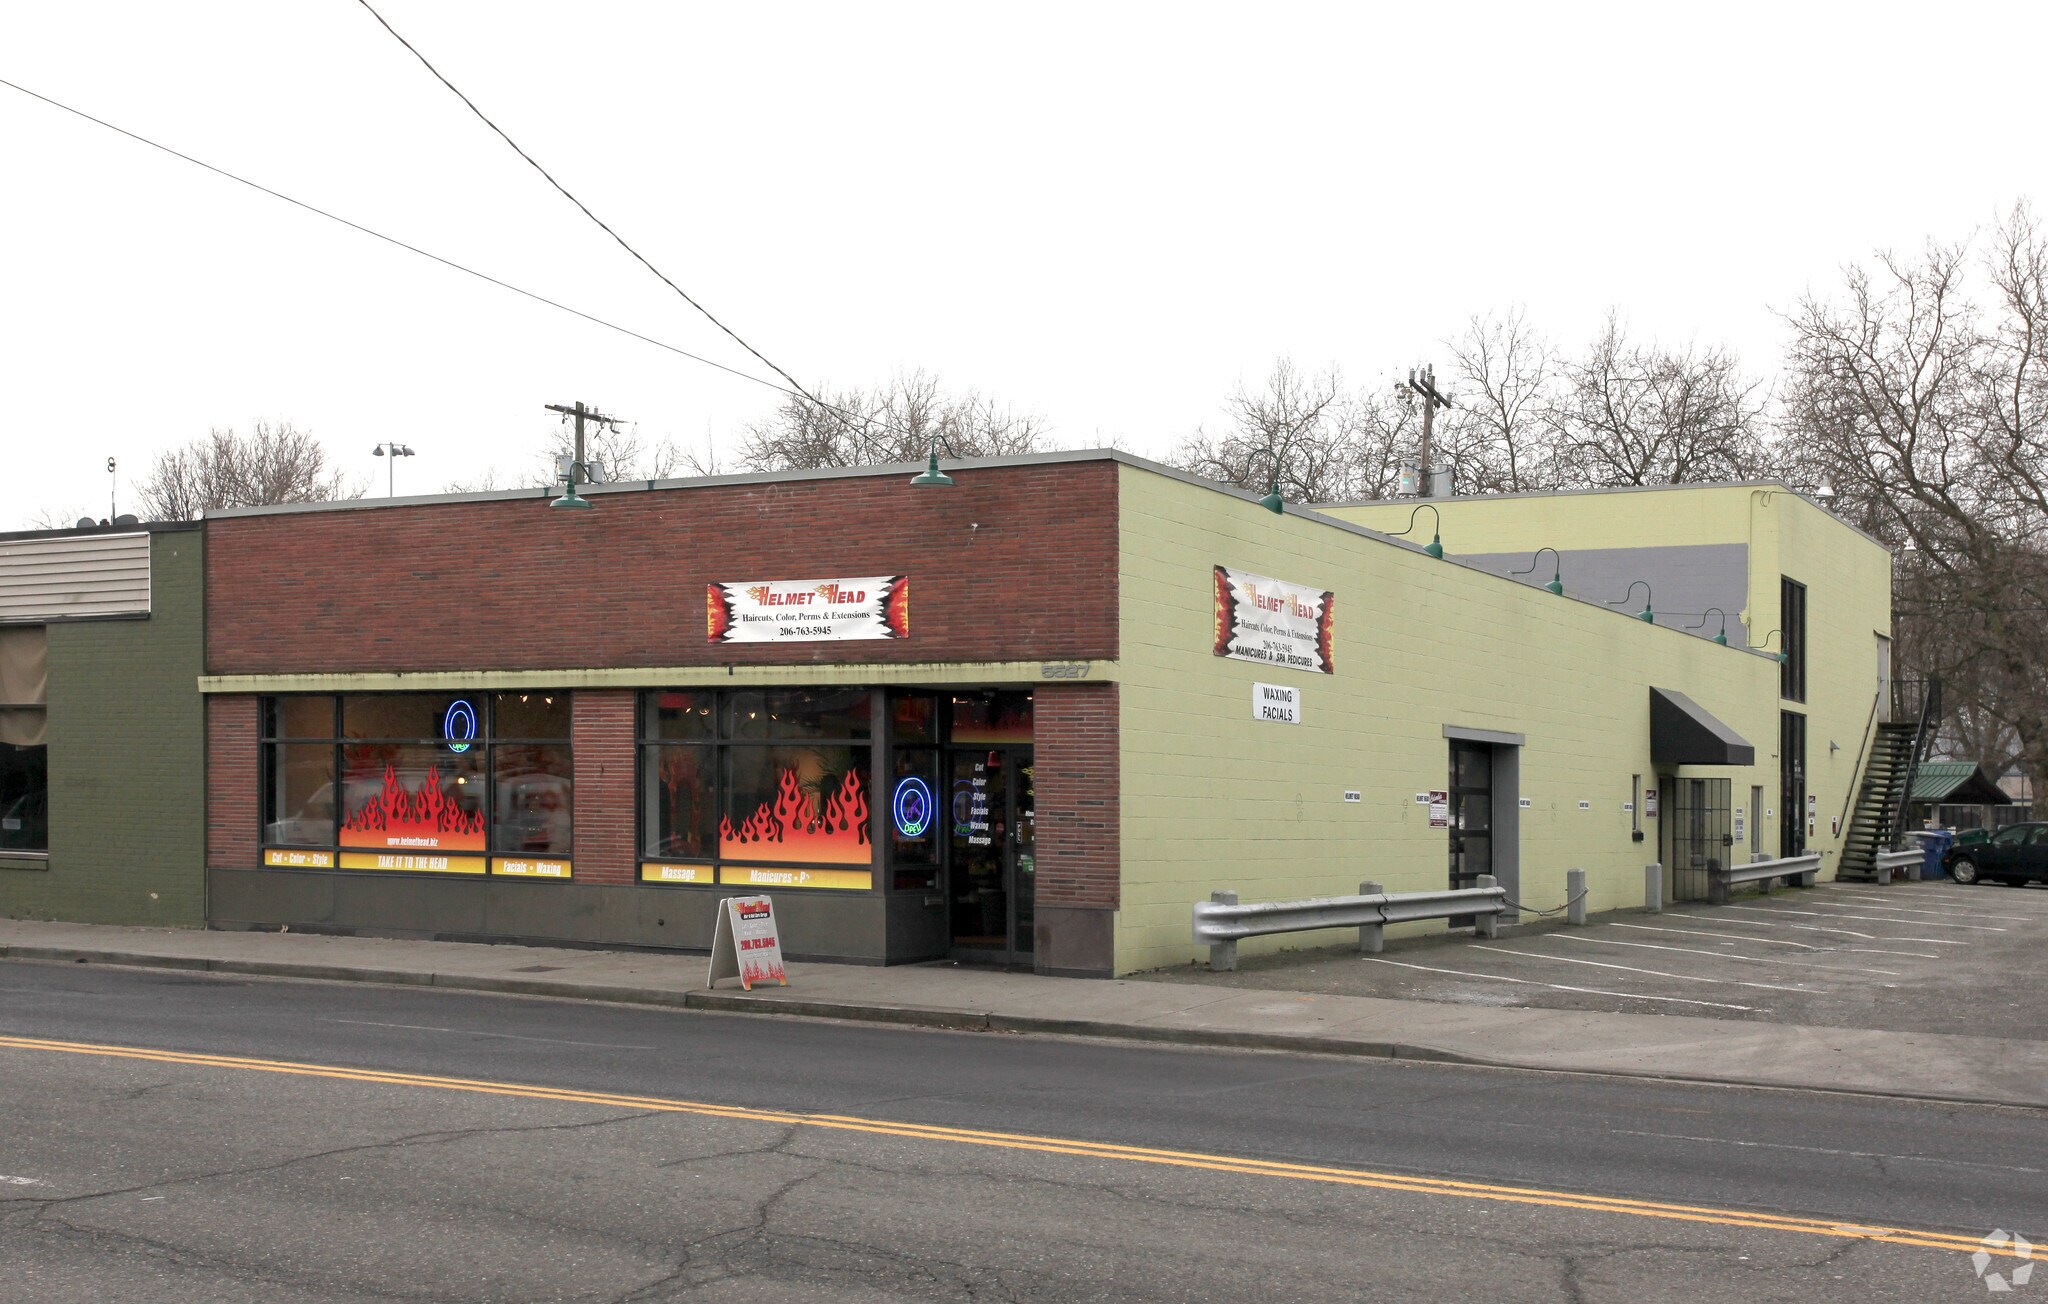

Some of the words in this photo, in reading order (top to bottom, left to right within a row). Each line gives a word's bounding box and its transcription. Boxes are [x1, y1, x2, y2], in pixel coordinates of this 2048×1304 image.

[757, 585, 816, 606] HELMET
[826, 584, 866, 604] HEAD
[1251, 584, 1285, 614] HELMET
[1292, 594, 1314, 619] HEAD
[742, 612, 774, 622] Haircuts,
[776, 612, 798, 622] Color,
[798, 612, 821, 621] Perms
[832, 610, 870, 620] Extensions
[779, 626, 832, 637] 206-763-5945
[1273, 626, 1286, 637] Perms
[1292, 628, 1314, 642] Extensions
[1234, 645, 1267, 660] MANICURES
[1268, 652, 1273, 660] &
[1276, 652, 1286, 663] SPA
[1287, 654, 1313, 667] PEDICURES
[1041, 664, 1090, 679] 5527
[1263, 686, 1292, 702] WAXING
[1262, 706, 1293, 722] FACIALS
[974, 763, 984, 772] Cut
[972, 778, 987, 786] Color
[973, 792, 986, 802] Style
[970, 807, 988, 816] Facials
[904, 822, 922, 834] OPEN
[970, 822, 989, 831] Waxing
[387, 836, 439, 847] www.helmethead.biz
[968, 836, 991, 845] Massage
[272, 853, 283, 864] Cut
[289, 853, 306, 864] Color
[312, 854, 328, 866] Style
[378, 855, 394, 868] TAKE
[396, 856, 403, 868] IT
[404, 856, 414, 868] TO
[415, 856, 428, 869] THE
[429, 857, 448, 870] HEAD
[502, 861, 527, 874] Facials
[536, 862, 562, 877] Waxing
[661, 866, 695, 881] Massage
[750, 870, 792, 884] Manicures
